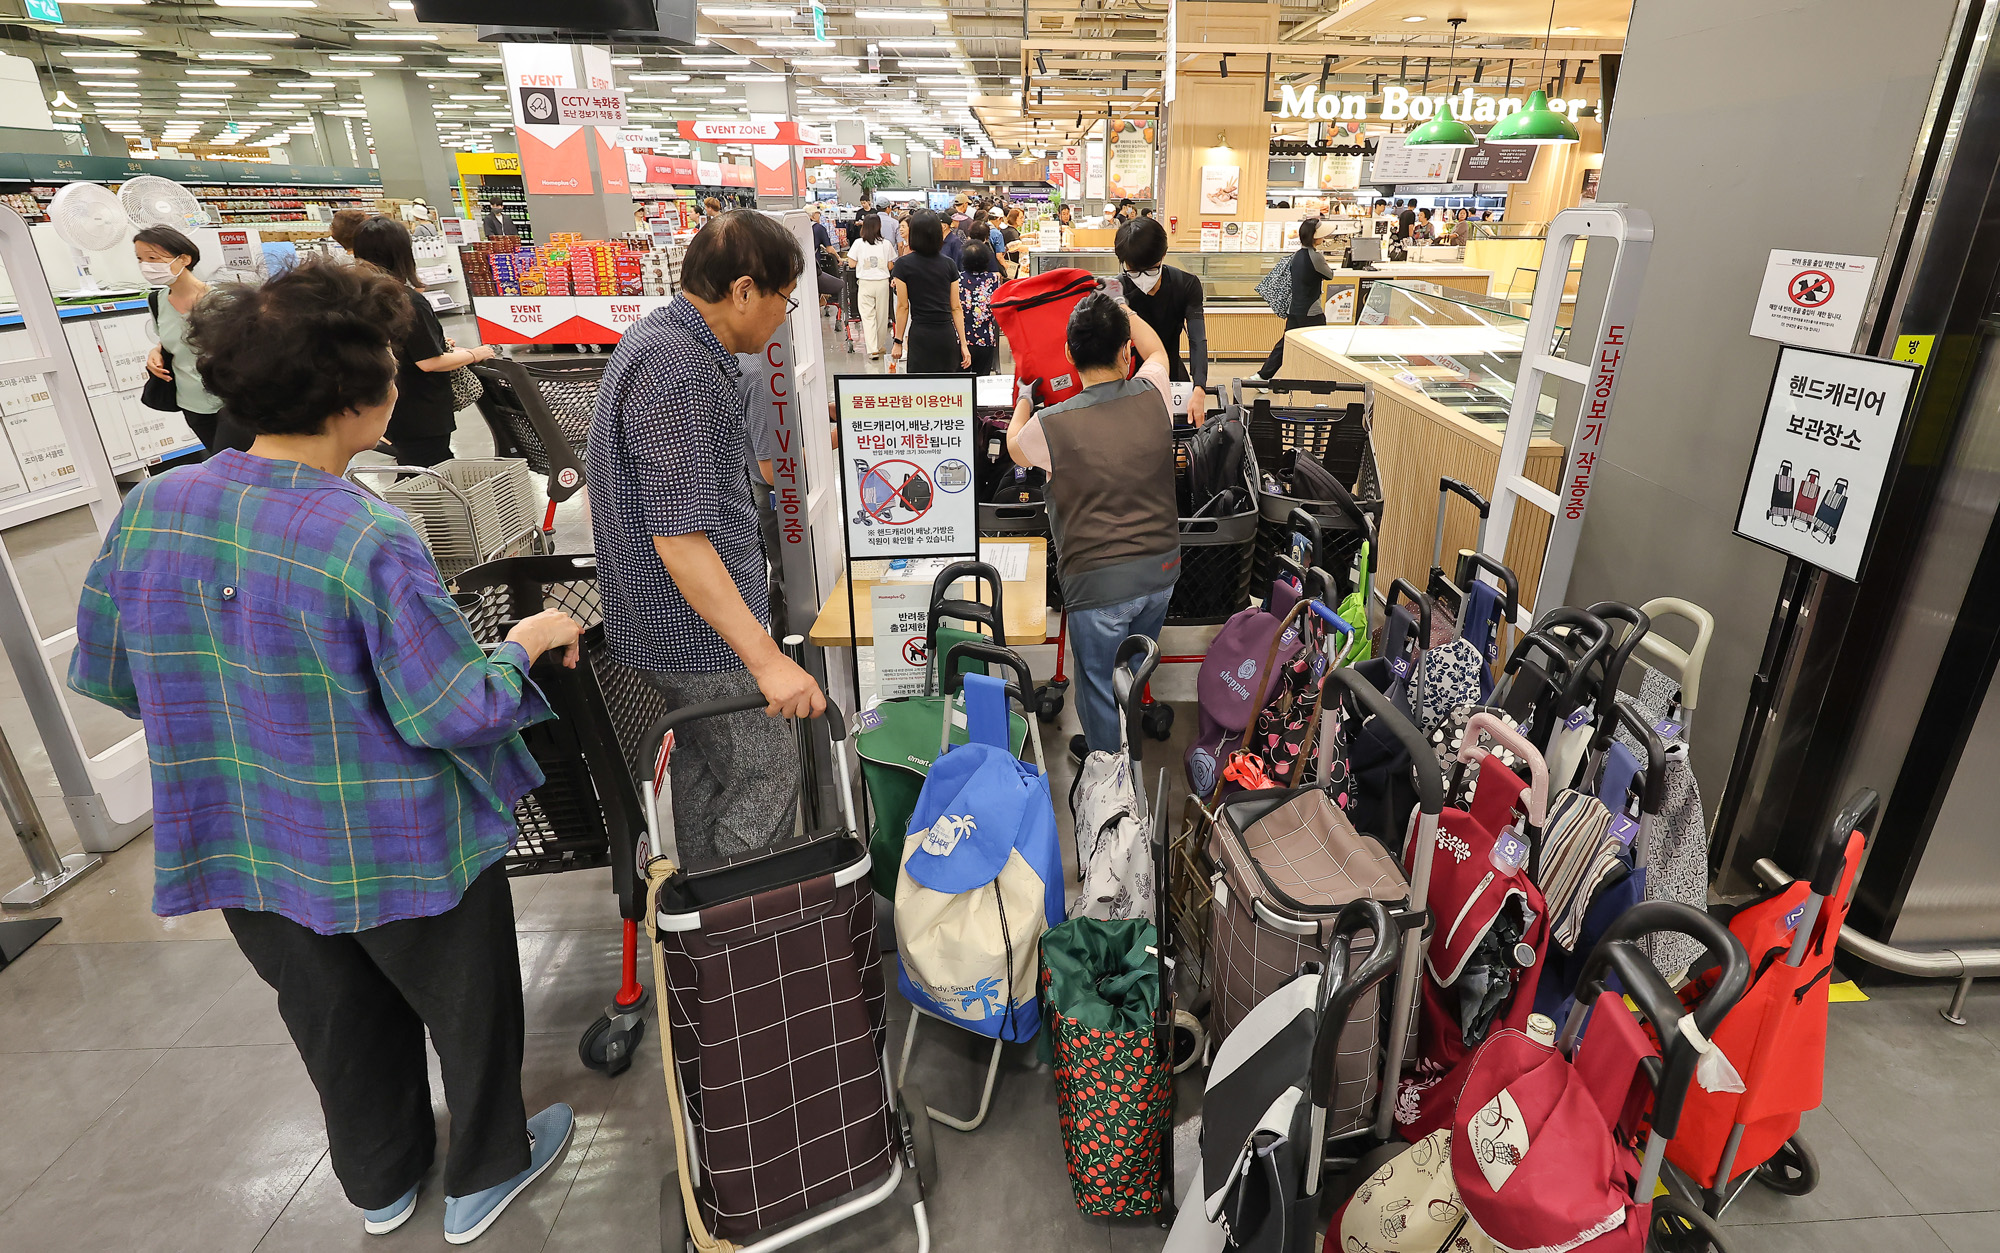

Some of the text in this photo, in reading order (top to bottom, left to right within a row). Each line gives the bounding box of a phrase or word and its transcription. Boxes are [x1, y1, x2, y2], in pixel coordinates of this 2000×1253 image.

[520, 75, 563, 86] EVENT
[561, 96, 621, 109] CCTV 녹화중
[1277, 84, 1587, 123] Mon Boulaner
[563, 110, 622, 119] 도난 경보기 작동 중
[705, 125, 766, 134] EVENT ZONE
[494, 158, 518, 170] HBAF
[510, 305, 541, 313] EVENT
[610, 305, 640, 313] EVENT
[513, 314, 543, 323] ZONE
[1789, 375, 1887, 416] 핸드캐리어
[851, 395, 963, 409] 물품 보관함 이용안내
[851, 420, 966, 432] 핸드캐리어,배낭,가방은
[1786, 414, 1862, 451] 보관장소
[857, 434, 962, 449] 반입이 제한됩니다
[877, 526, 954, 536] 핸드캐리어,배낭,가방은
[868, 535, 955, 546] 직원이 확인할 수 있습니다
[898, 612, 930, 621] 반려동
[1282, 628, 1296, 640] 25
[1488, 643, 1497, 655] 16
[1317, 658, 1323, 669] 6
[1393, 660, 1407, 672] 29
[1219, 669, 1250, 701] shopping
[861, 712, 878, 727] 31
[1572, 715, 1583, 724] 3
[907, 755, 929, 768] emart
[1619, 819, 1632, 833] 7
[1504, 840, 1518, 855] 8
[1791, 907, 1805, 921] 2
[950, 984, 975, 992] Smart
